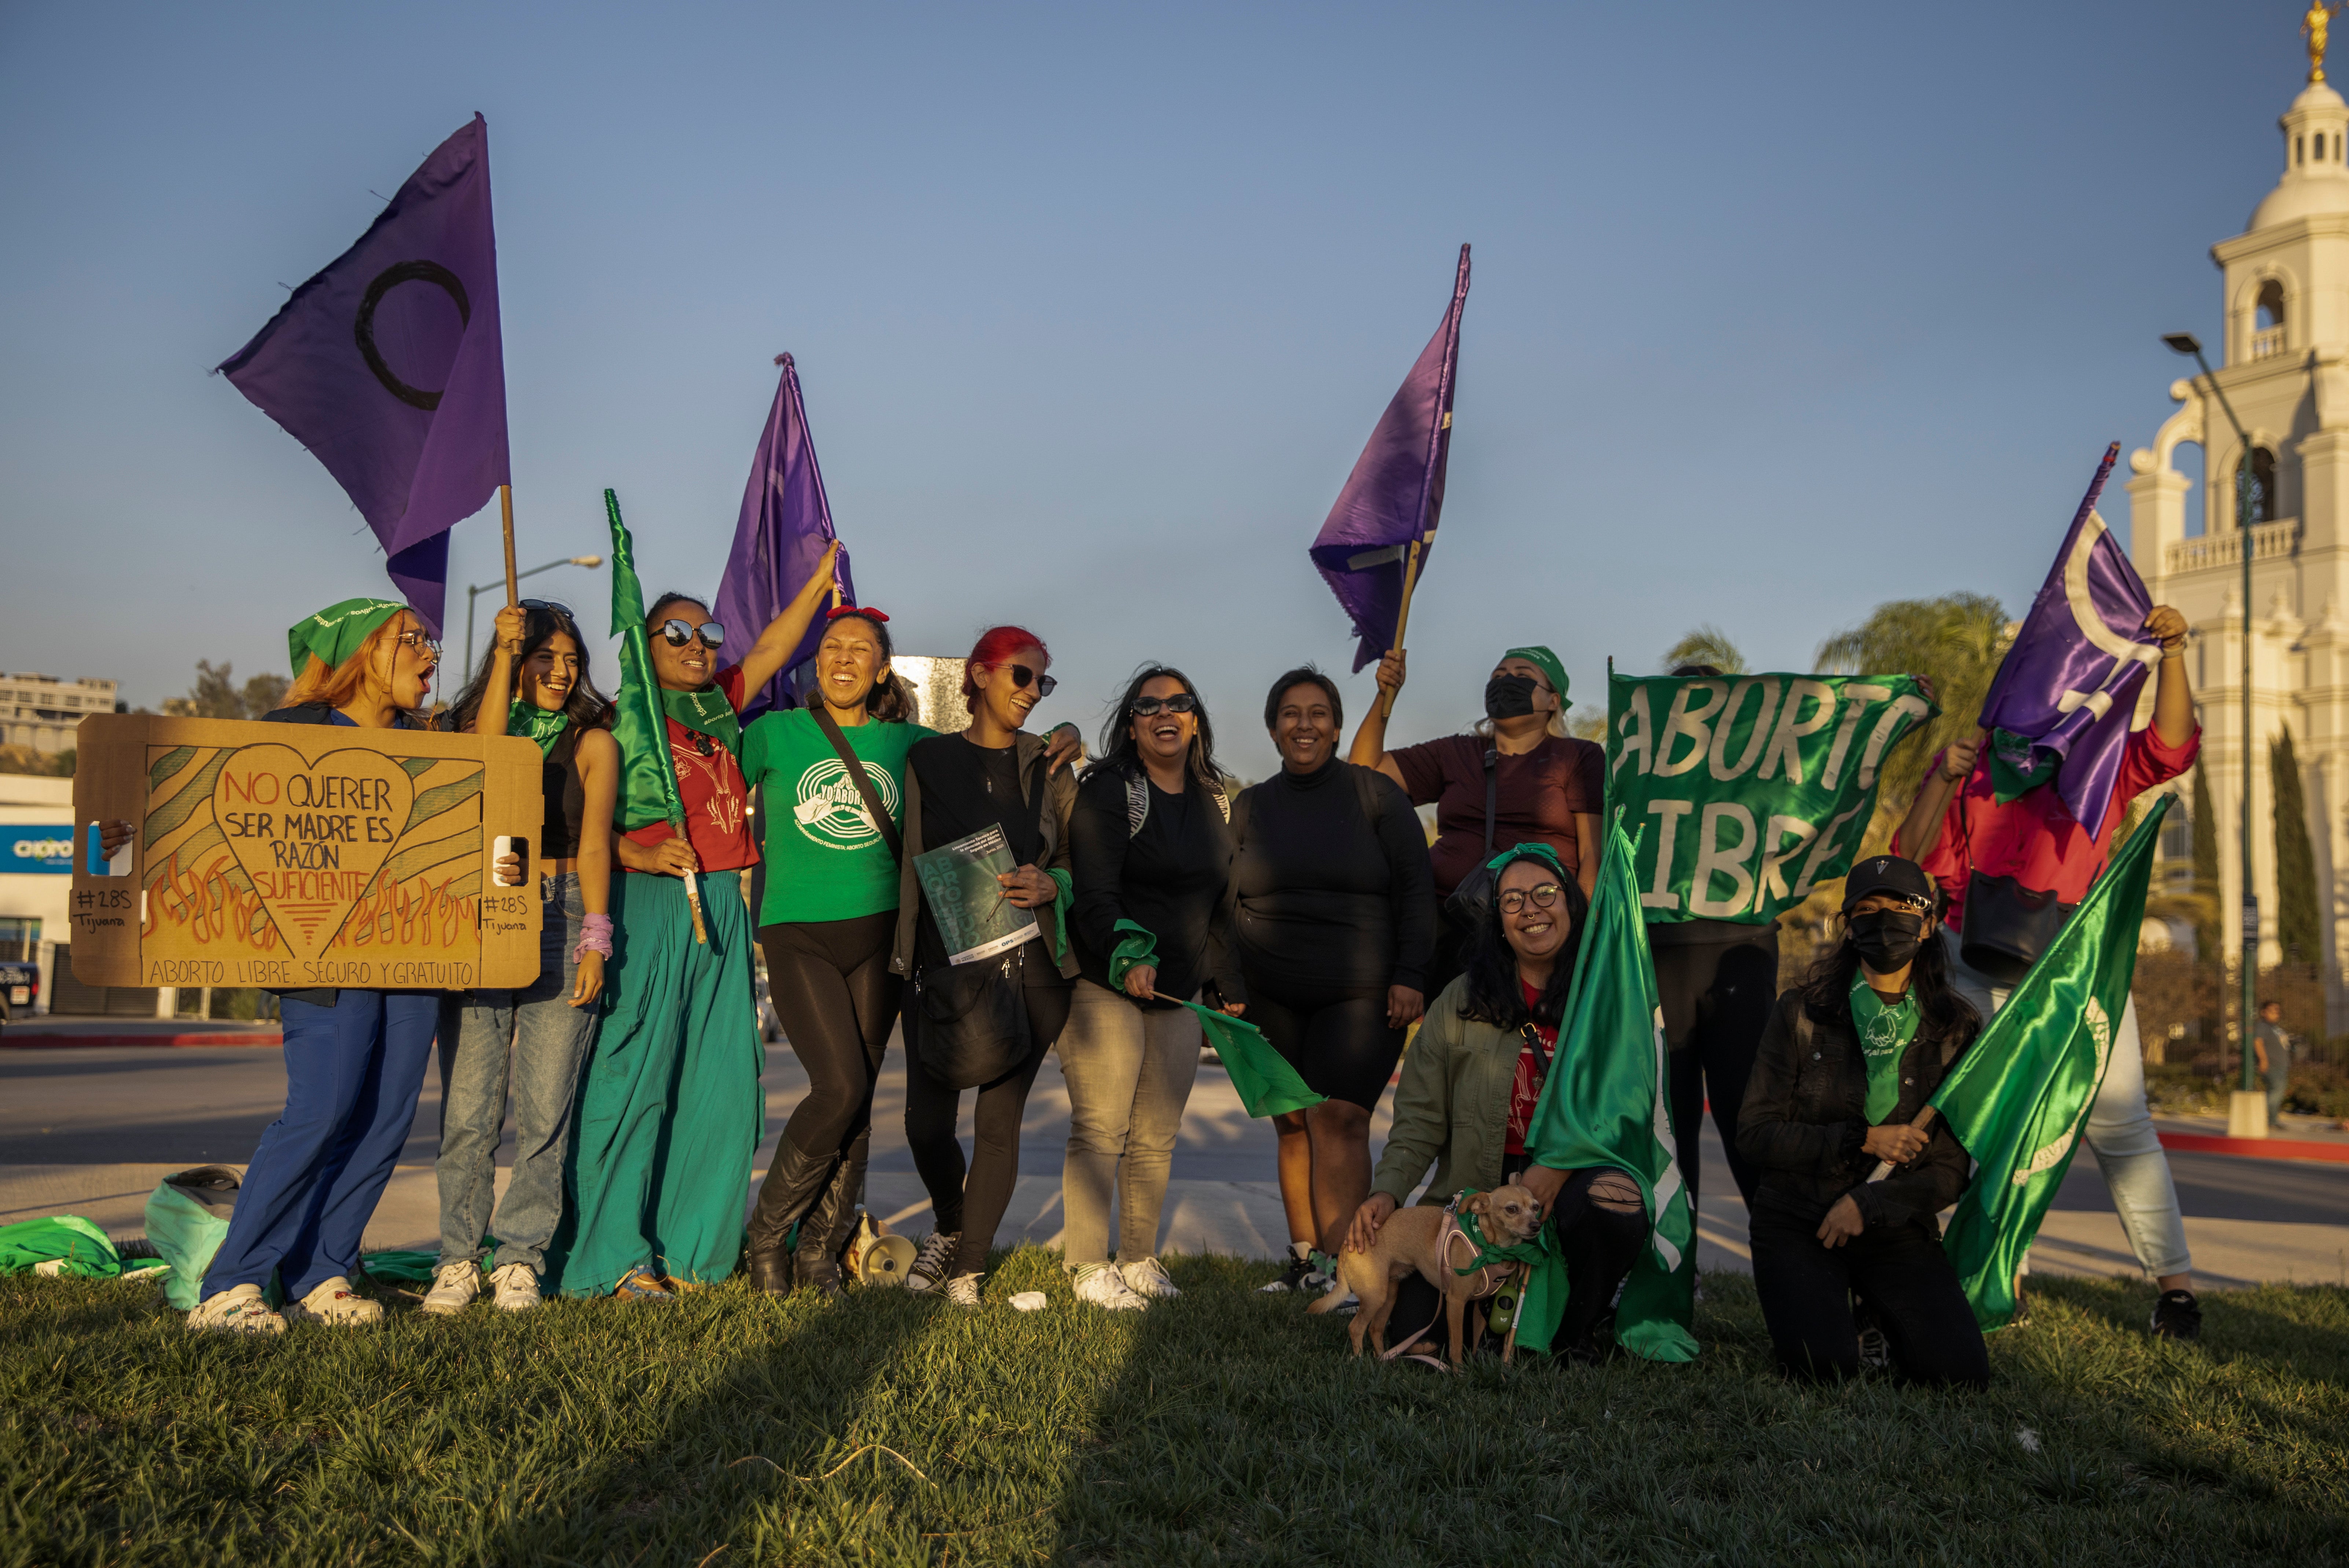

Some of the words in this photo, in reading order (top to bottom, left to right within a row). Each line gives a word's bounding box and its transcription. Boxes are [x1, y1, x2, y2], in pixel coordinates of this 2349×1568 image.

[704, 714, 724, 725] aborto
[225, 771, 279, 804] NO
[287, 774, 393, 812] QUERER
[821, 785, 833, 801] YO
[225, 812, 274, 838] SER
[285, 812, 358, 842] MADRE
[366, 816, 394, 842] ES
[864, 837, 880, 847] SEGURO
[952, 839, 975, 851] Lineamiento
[975, 833, 990, 841] Técnico
[964, 842, 981, 851] atención
[269, 840, 339, 870] RAZÓN
[1614, 798, 1866, 917] IBRE
[253, 871, 370, 901] SUFICIENTE
[77, 889, 132, 909] #28S
[484, 895, 528, 915] #28S
[73, 913, 125, 934] Tijuana
[482, 918, 526, 935] Tijuana
[1001, 939, 1014, 947] OPS
[150, 960, 224, 983] ABORTO
[304, 961, 371, 983] SEGURO
[380, 962, 390, 984] Y
[393, 962, 472, 985] GRATUITO
